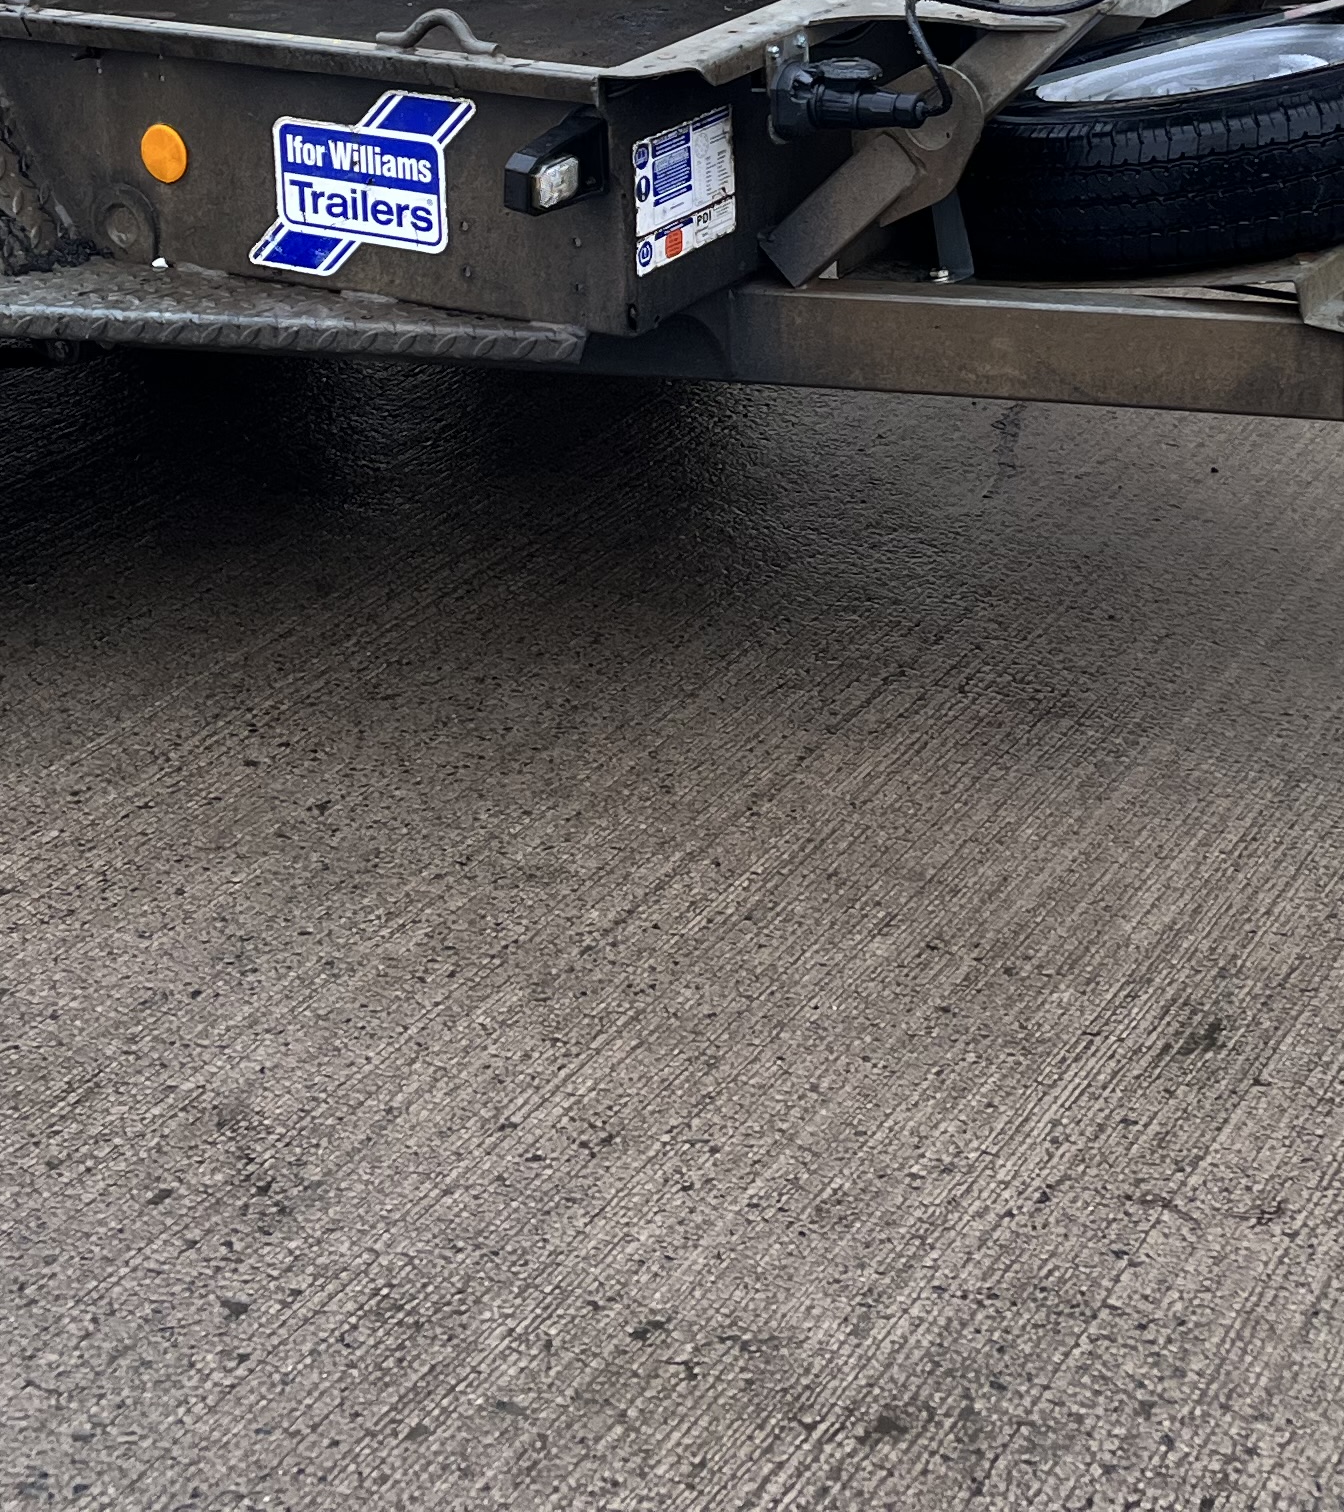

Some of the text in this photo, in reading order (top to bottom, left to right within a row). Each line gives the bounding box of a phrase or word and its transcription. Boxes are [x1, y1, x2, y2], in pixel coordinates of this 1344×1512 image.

[285, 133, 432, 183] Ifor Williams
[288, 179, 434, 233] Trailers
[697, 209, 712, 227] PDI
